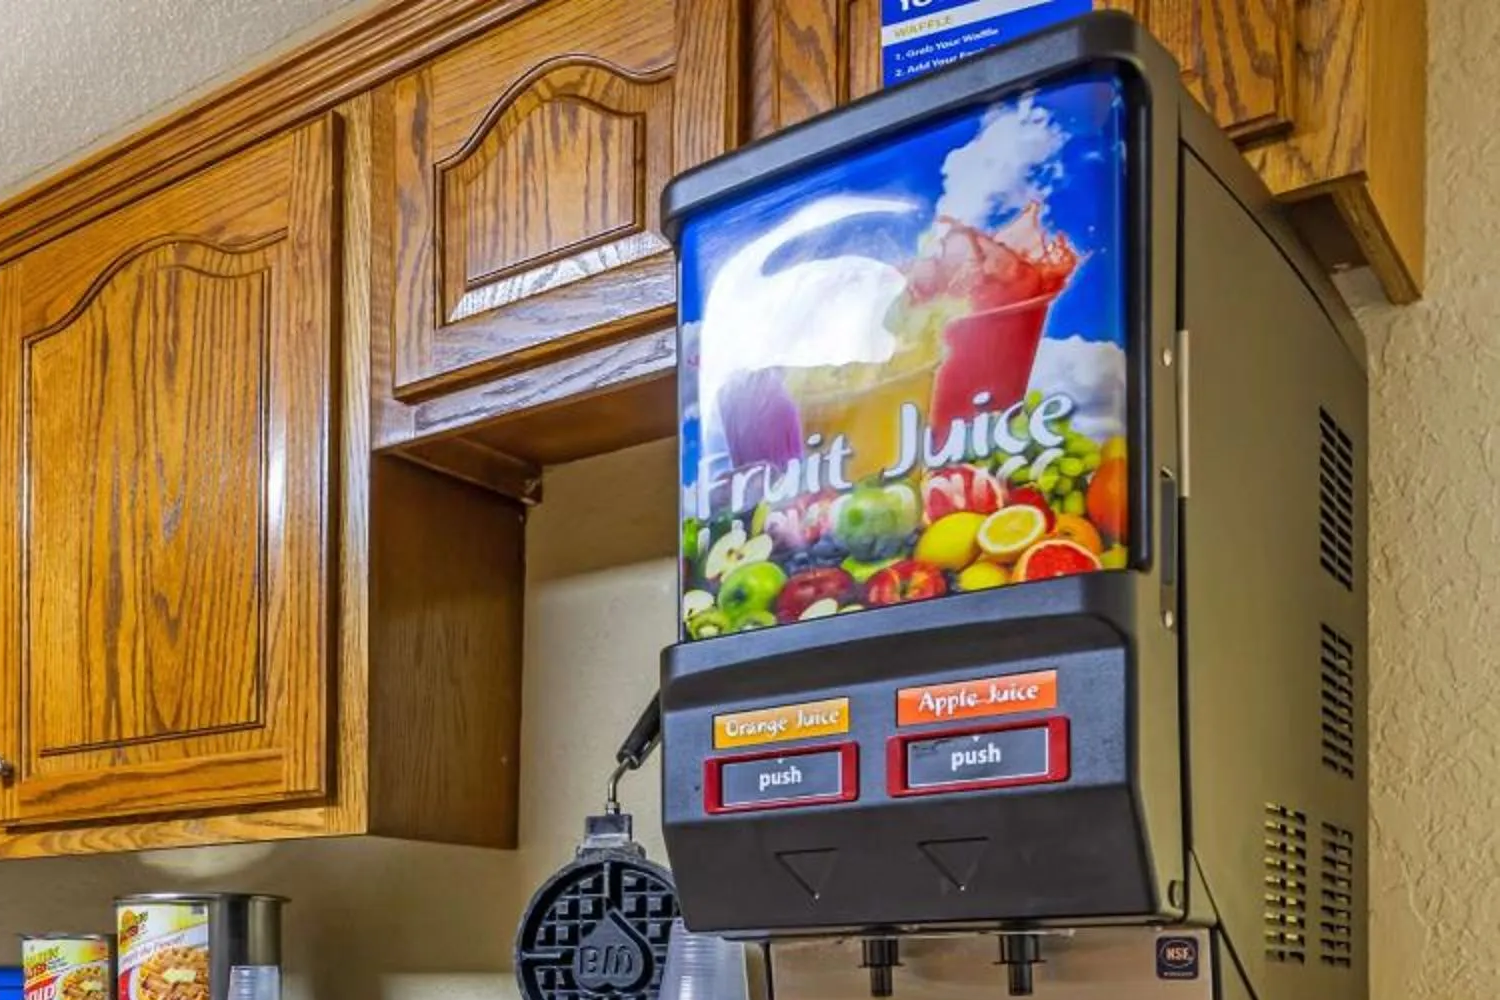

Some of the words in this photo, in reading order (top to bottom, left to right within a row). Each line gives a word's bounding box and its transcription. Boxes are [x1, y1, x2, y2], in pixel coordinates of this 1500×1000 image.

[698, 433, 853, 520] Fruit
[882, 391, 1073, 480] Juice
[918, 689, 977, 716] Apple
[986, 683, 1040, 704] Juice
[724, 717, 789, 738] Orange
[796, 708, 840, 728] Juice
[951, 742, 1001, 772] push
[759, 765, 802, 792] push
